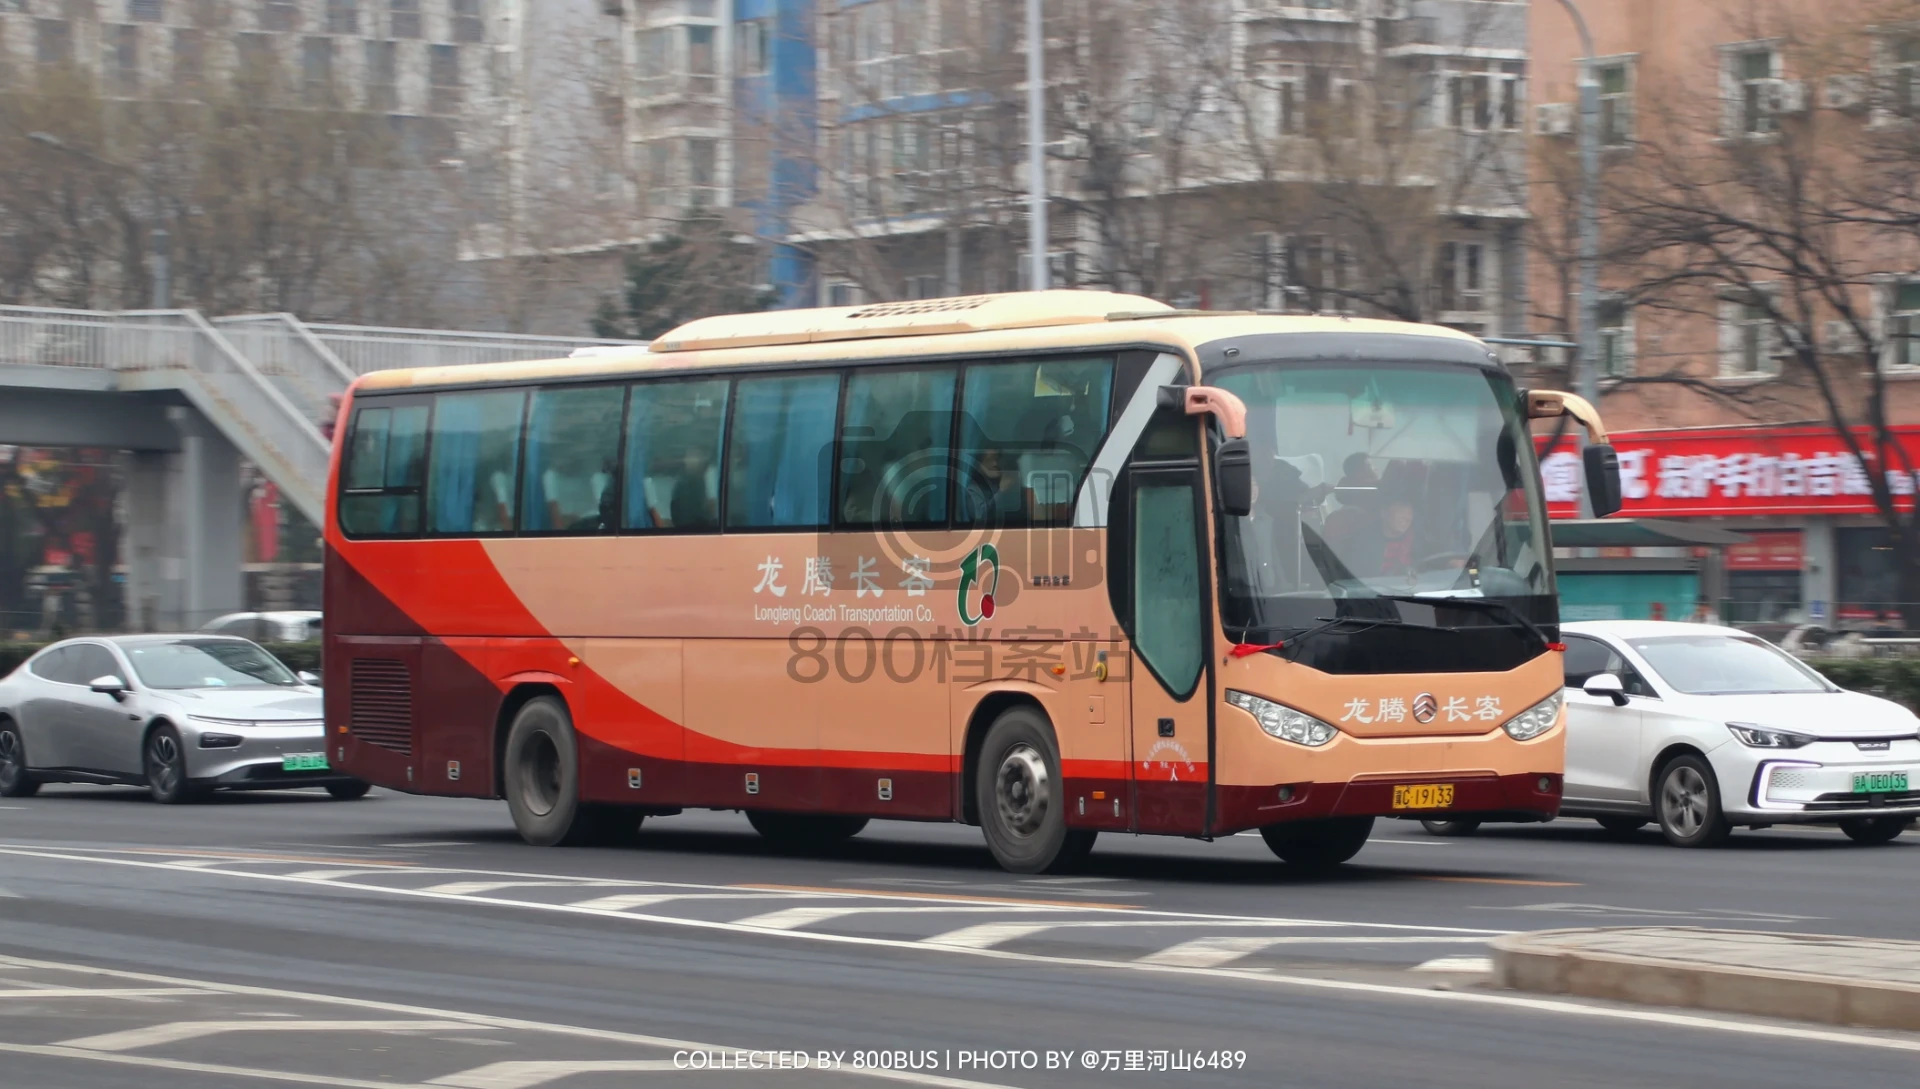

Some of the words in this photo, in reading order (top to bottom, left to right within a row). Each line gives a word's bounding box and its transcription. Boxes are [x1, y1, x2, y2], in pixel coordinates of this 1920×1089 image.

[753, 554, 935, 598] 龙腾长客
[755, 605, 801, 625] Longteng
[803, 604, 836, 622] Coach
[839, 604, 914, 625] Transportation
[916, 604, 935, 622] Co.
